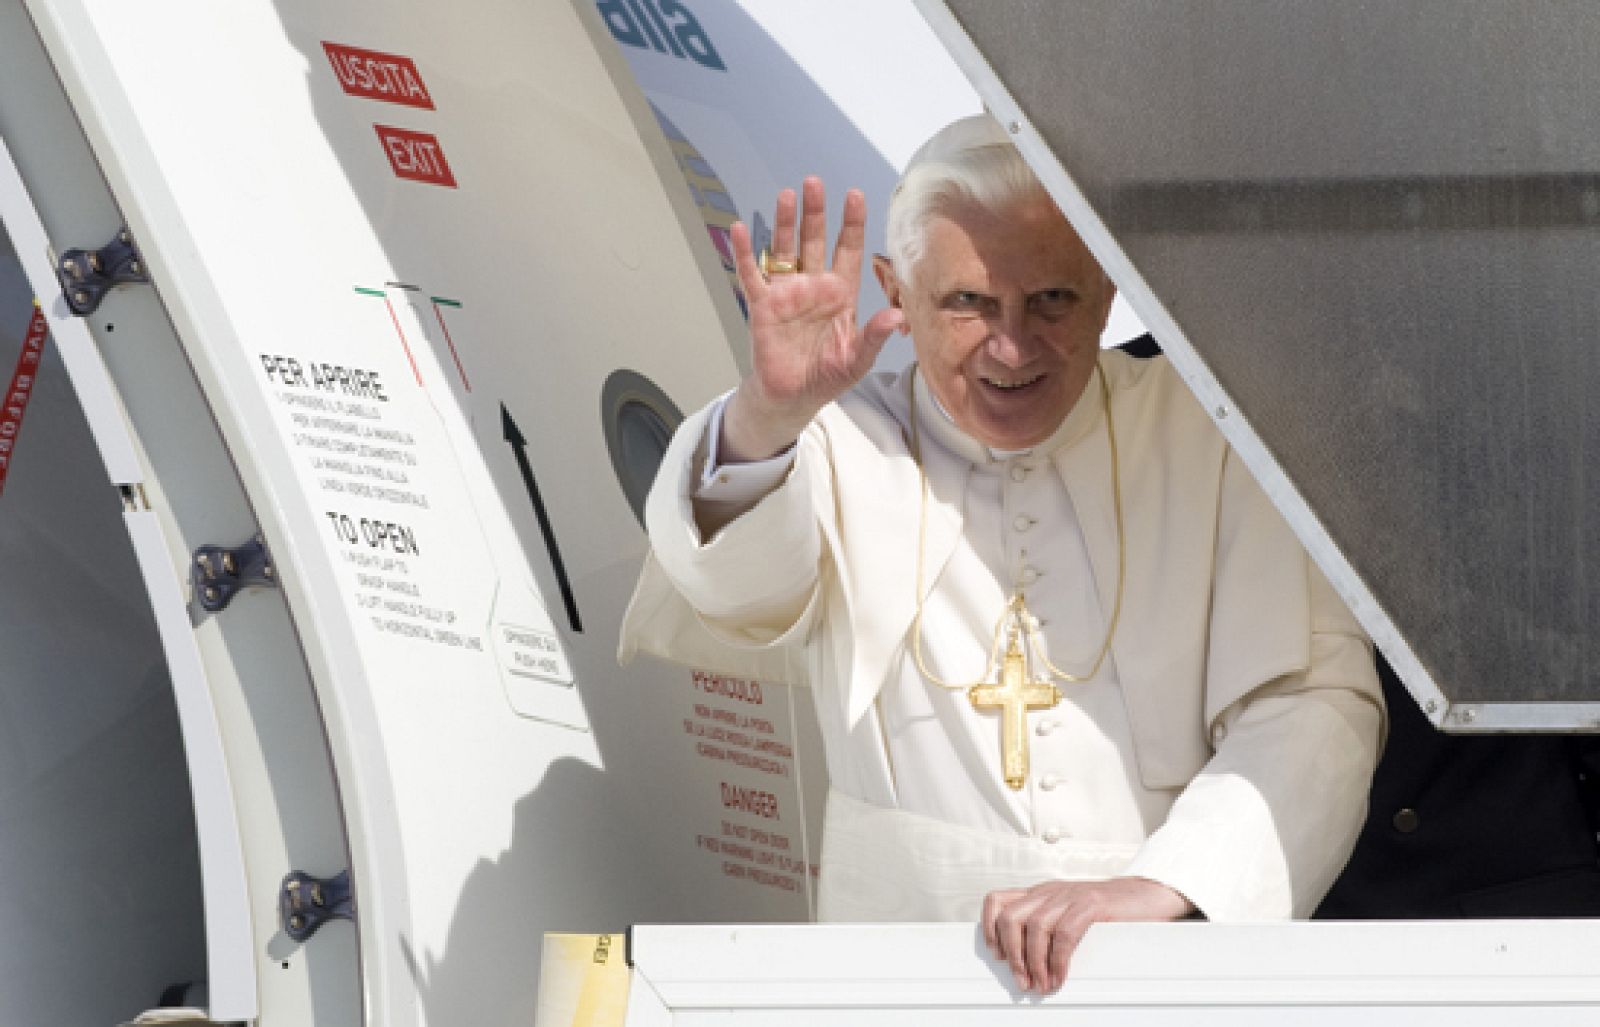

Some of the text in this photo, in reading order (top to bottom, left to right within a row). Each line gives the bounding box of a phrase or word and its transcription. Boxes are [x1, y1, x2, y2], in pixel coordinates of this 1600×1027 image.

[328, 50, 430, 100] USCITA
[383, 135, 445, 177] EXIT
[259, 354, 390, 402] PER APRIRE
[326, 511, 419, 556] TO OPEN
[691, 669, 763, 704] PERICOLO
[720, 781, 780, 820] DANGER
